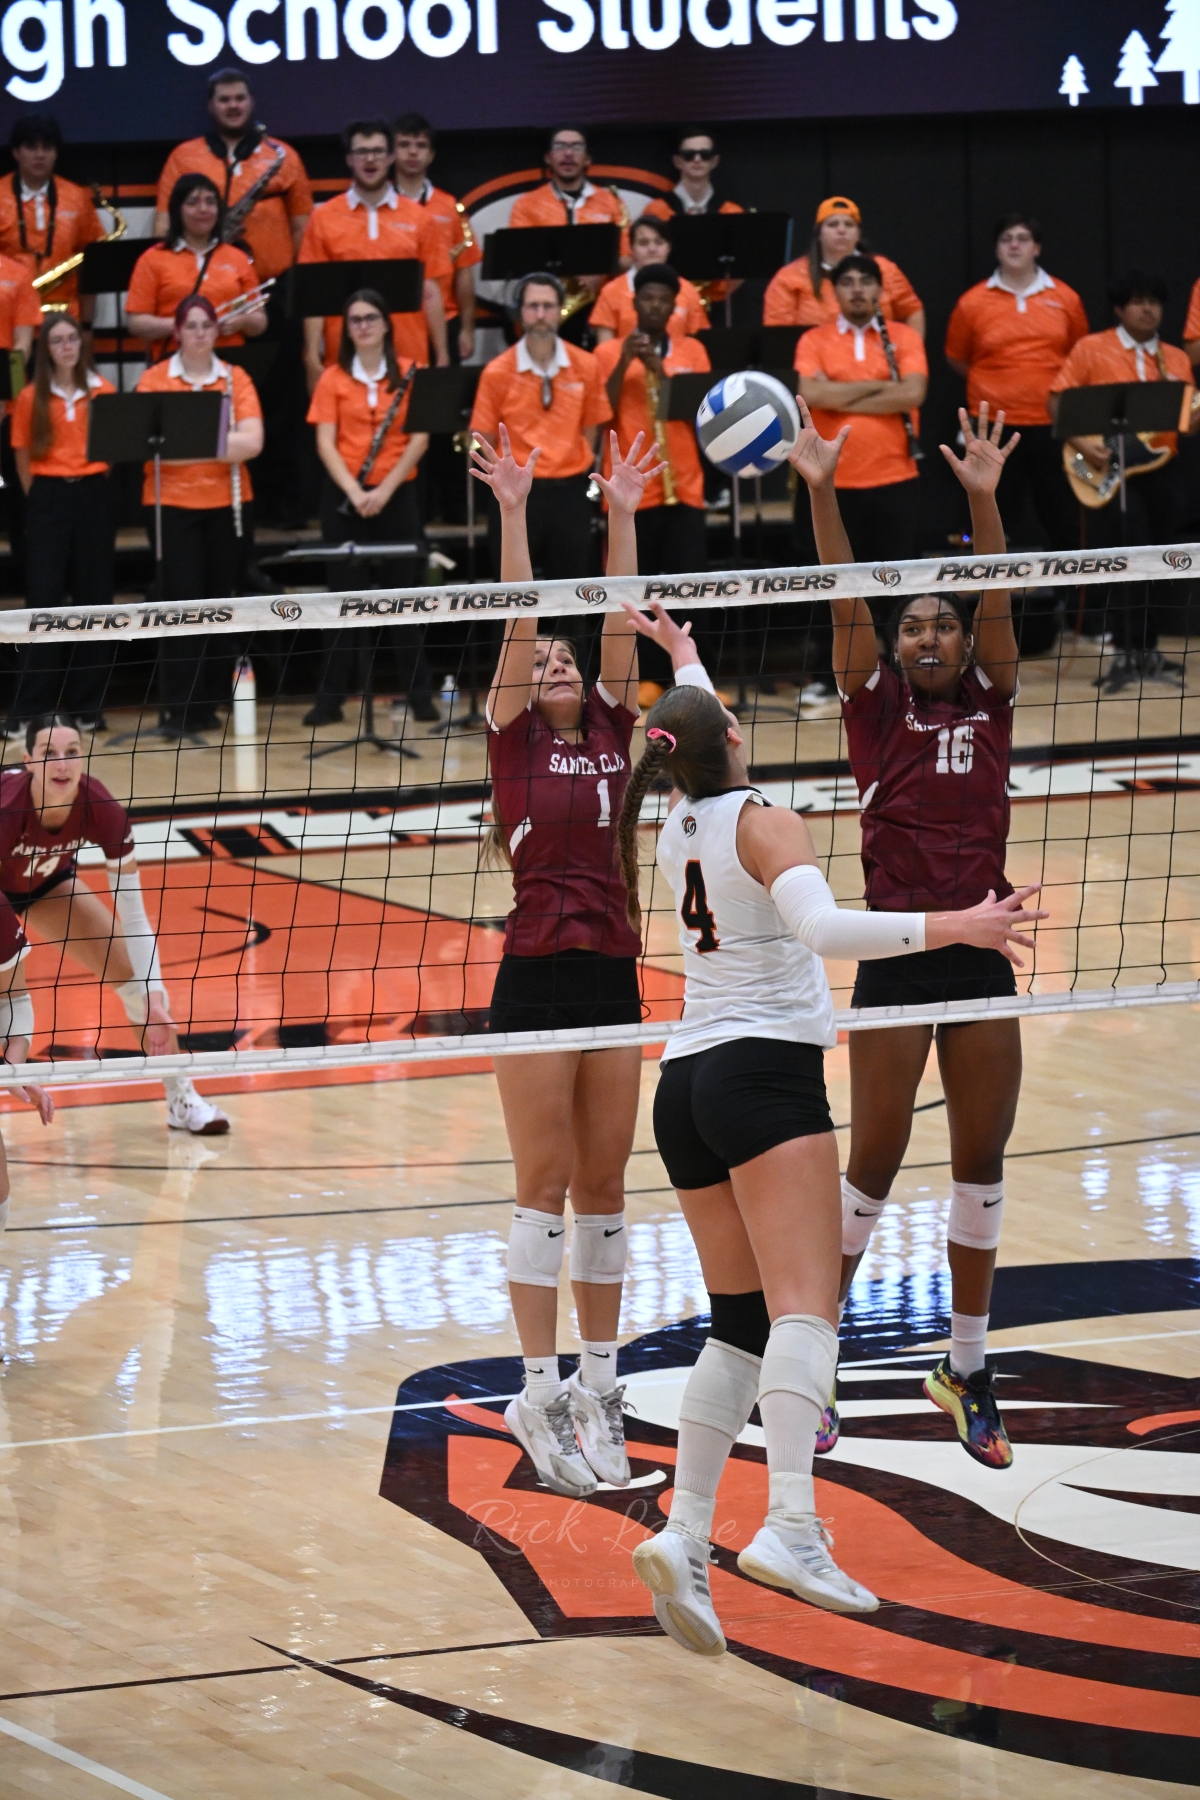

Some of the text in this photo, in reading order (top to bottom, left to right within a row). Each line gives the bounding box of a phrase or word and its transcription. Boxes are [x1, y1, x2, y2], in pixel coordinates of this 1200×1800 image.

[167, 0, 498, 65] School
[935, 555, 1129, 582] PACIFIC TIGERS
[643, 572, 838, 600] PACIFIC TIGERS
[338, 589, 541, 618] PACIFIC TIGERS
[27, 604, 235, 633] PACIFIC TIGERS
[549, 753, 598, 775] SANTA
[936, 725, 975, 774] 16
[596, 779, 611, 827] 1
[22, 855, 61, 878] 14
[681, 859, 721, 954] 4
